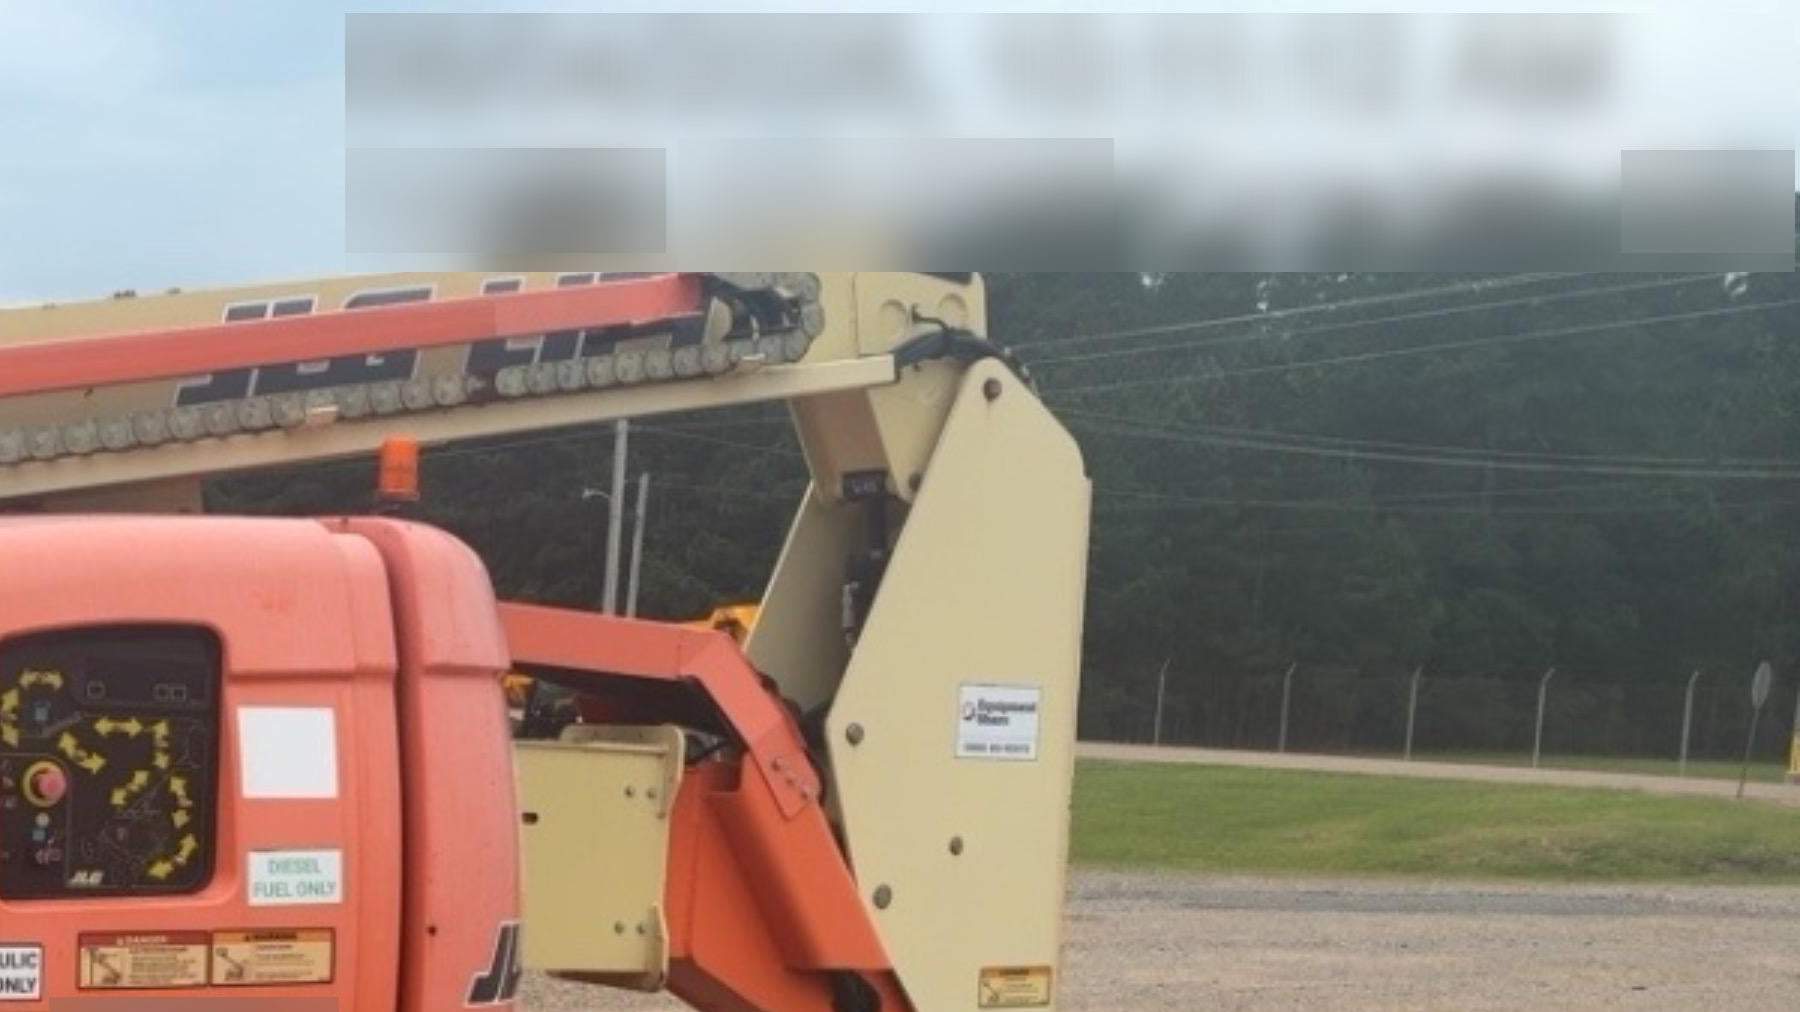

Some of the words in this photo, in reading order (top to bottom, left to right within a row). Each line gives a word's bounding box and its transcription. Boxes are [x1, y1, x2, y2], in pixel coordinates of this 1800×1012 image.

[267, 858, 320, 873] DIESEL
[254, 881, 292, 897] FUEL
[296, 880, 337, 896] ONLY
